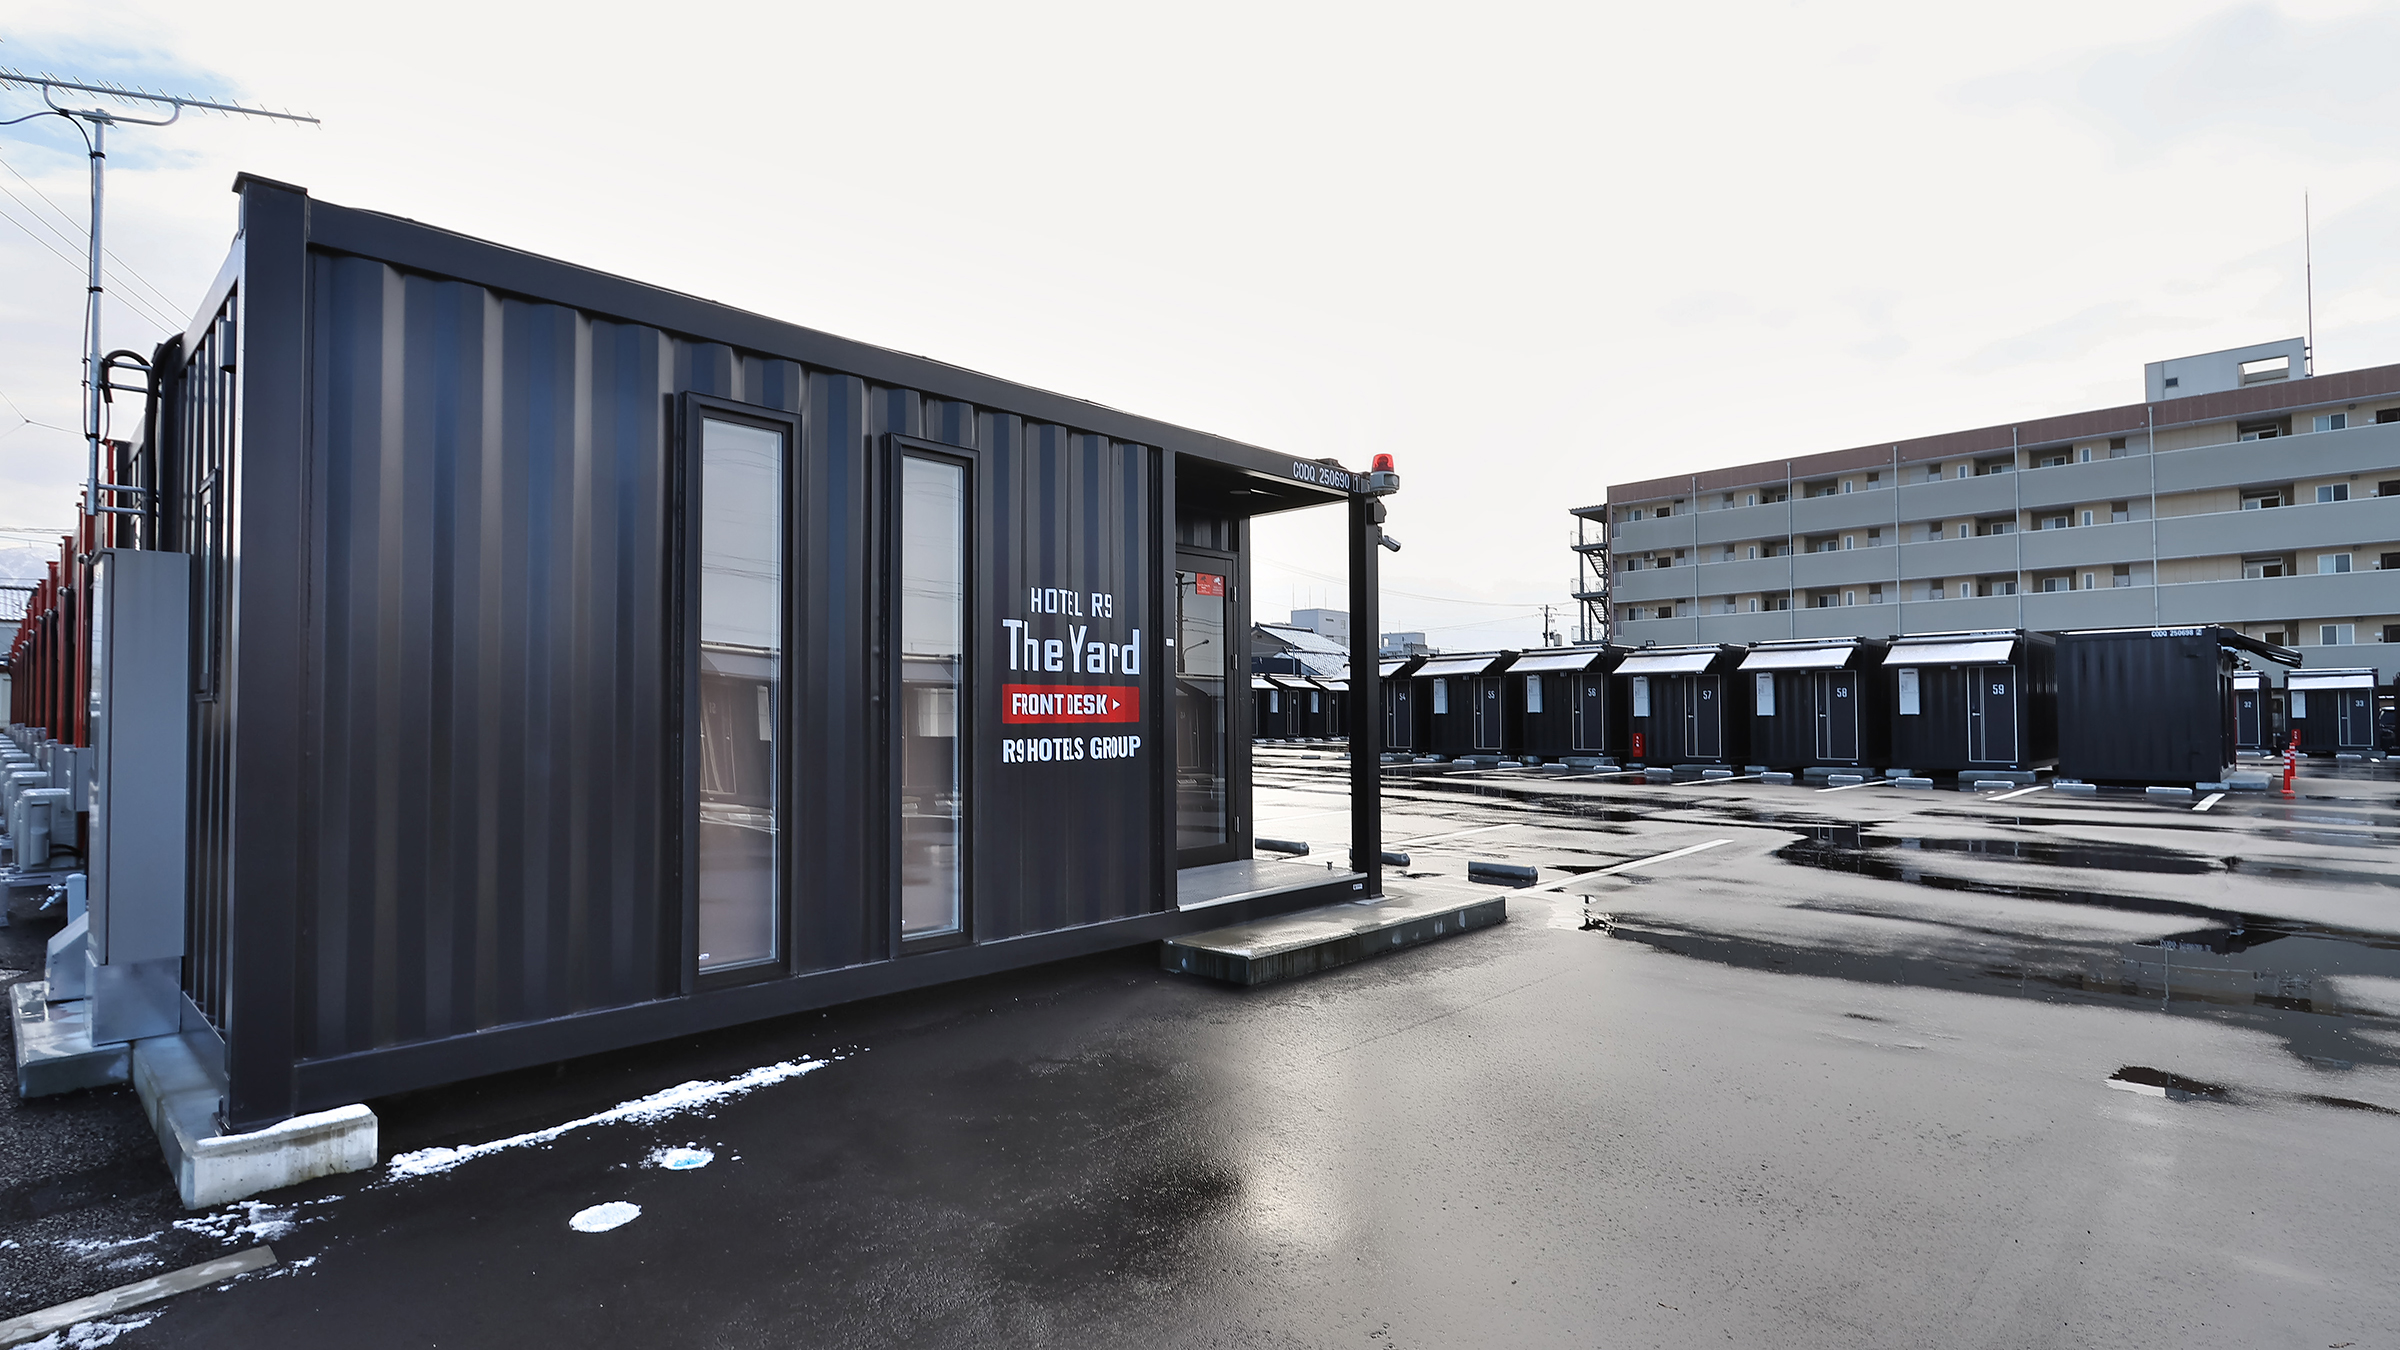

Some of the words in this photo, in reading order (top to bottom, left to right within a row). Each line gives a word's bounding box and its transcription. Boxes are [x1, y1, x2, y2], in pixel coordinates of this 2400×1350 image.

[1293, 461, 1316, 482] CODQ
[1320, 468, 1350, 489] 250690
[1030, 586, 1083, 617] HOTEL
[1091, 592, 1113, 618] R9
[1587, 687, 1597, 697] 56
[1702, 690, 1712, 700] 57
[1836, 687, 1848, 698] 58
[1992, 684, 2005, 695] 59
[1012, 692, 1064, 715] FRONT
[1067, 693, 1108, 715] DESK
[1002, 739, 1025, 763] R9
[1027, 736, 1085, 762] HOTELS
[1090, 735, 1141, 759] GROUP
